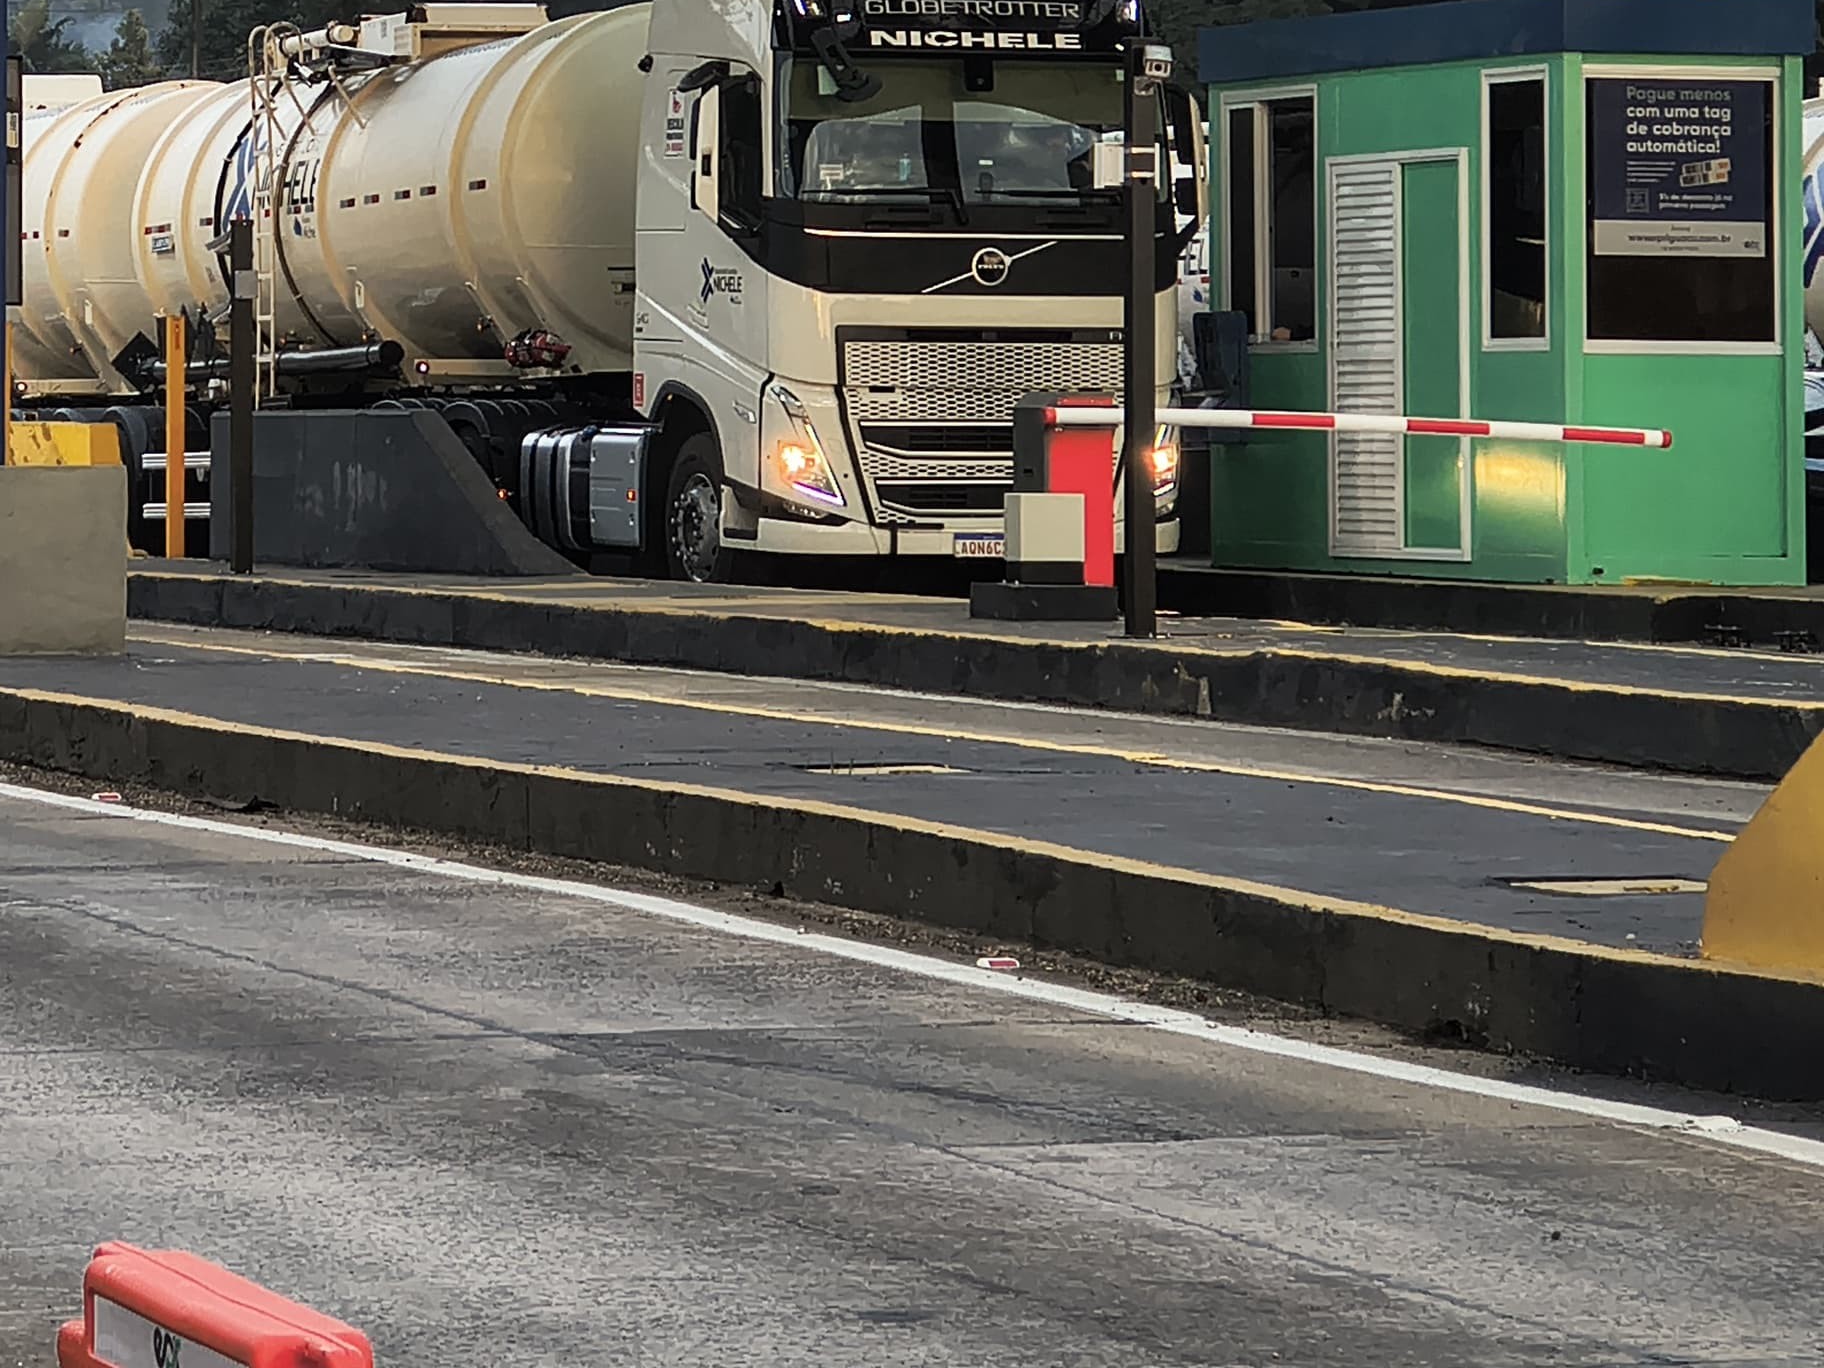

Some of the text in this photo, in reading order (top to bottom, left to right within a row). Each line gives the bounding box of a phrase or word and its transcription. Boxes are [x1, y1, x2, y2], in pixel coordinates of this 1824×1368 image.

[869, 30, 1082, 49] NICHELE
[1626, 86, 1732, 104] Pague menos
[1626, 105, 1731, 121] com uma tag
[1626, 121, 1731, 139] de cobrança
[1626, 139, 1720, 153] automática!
